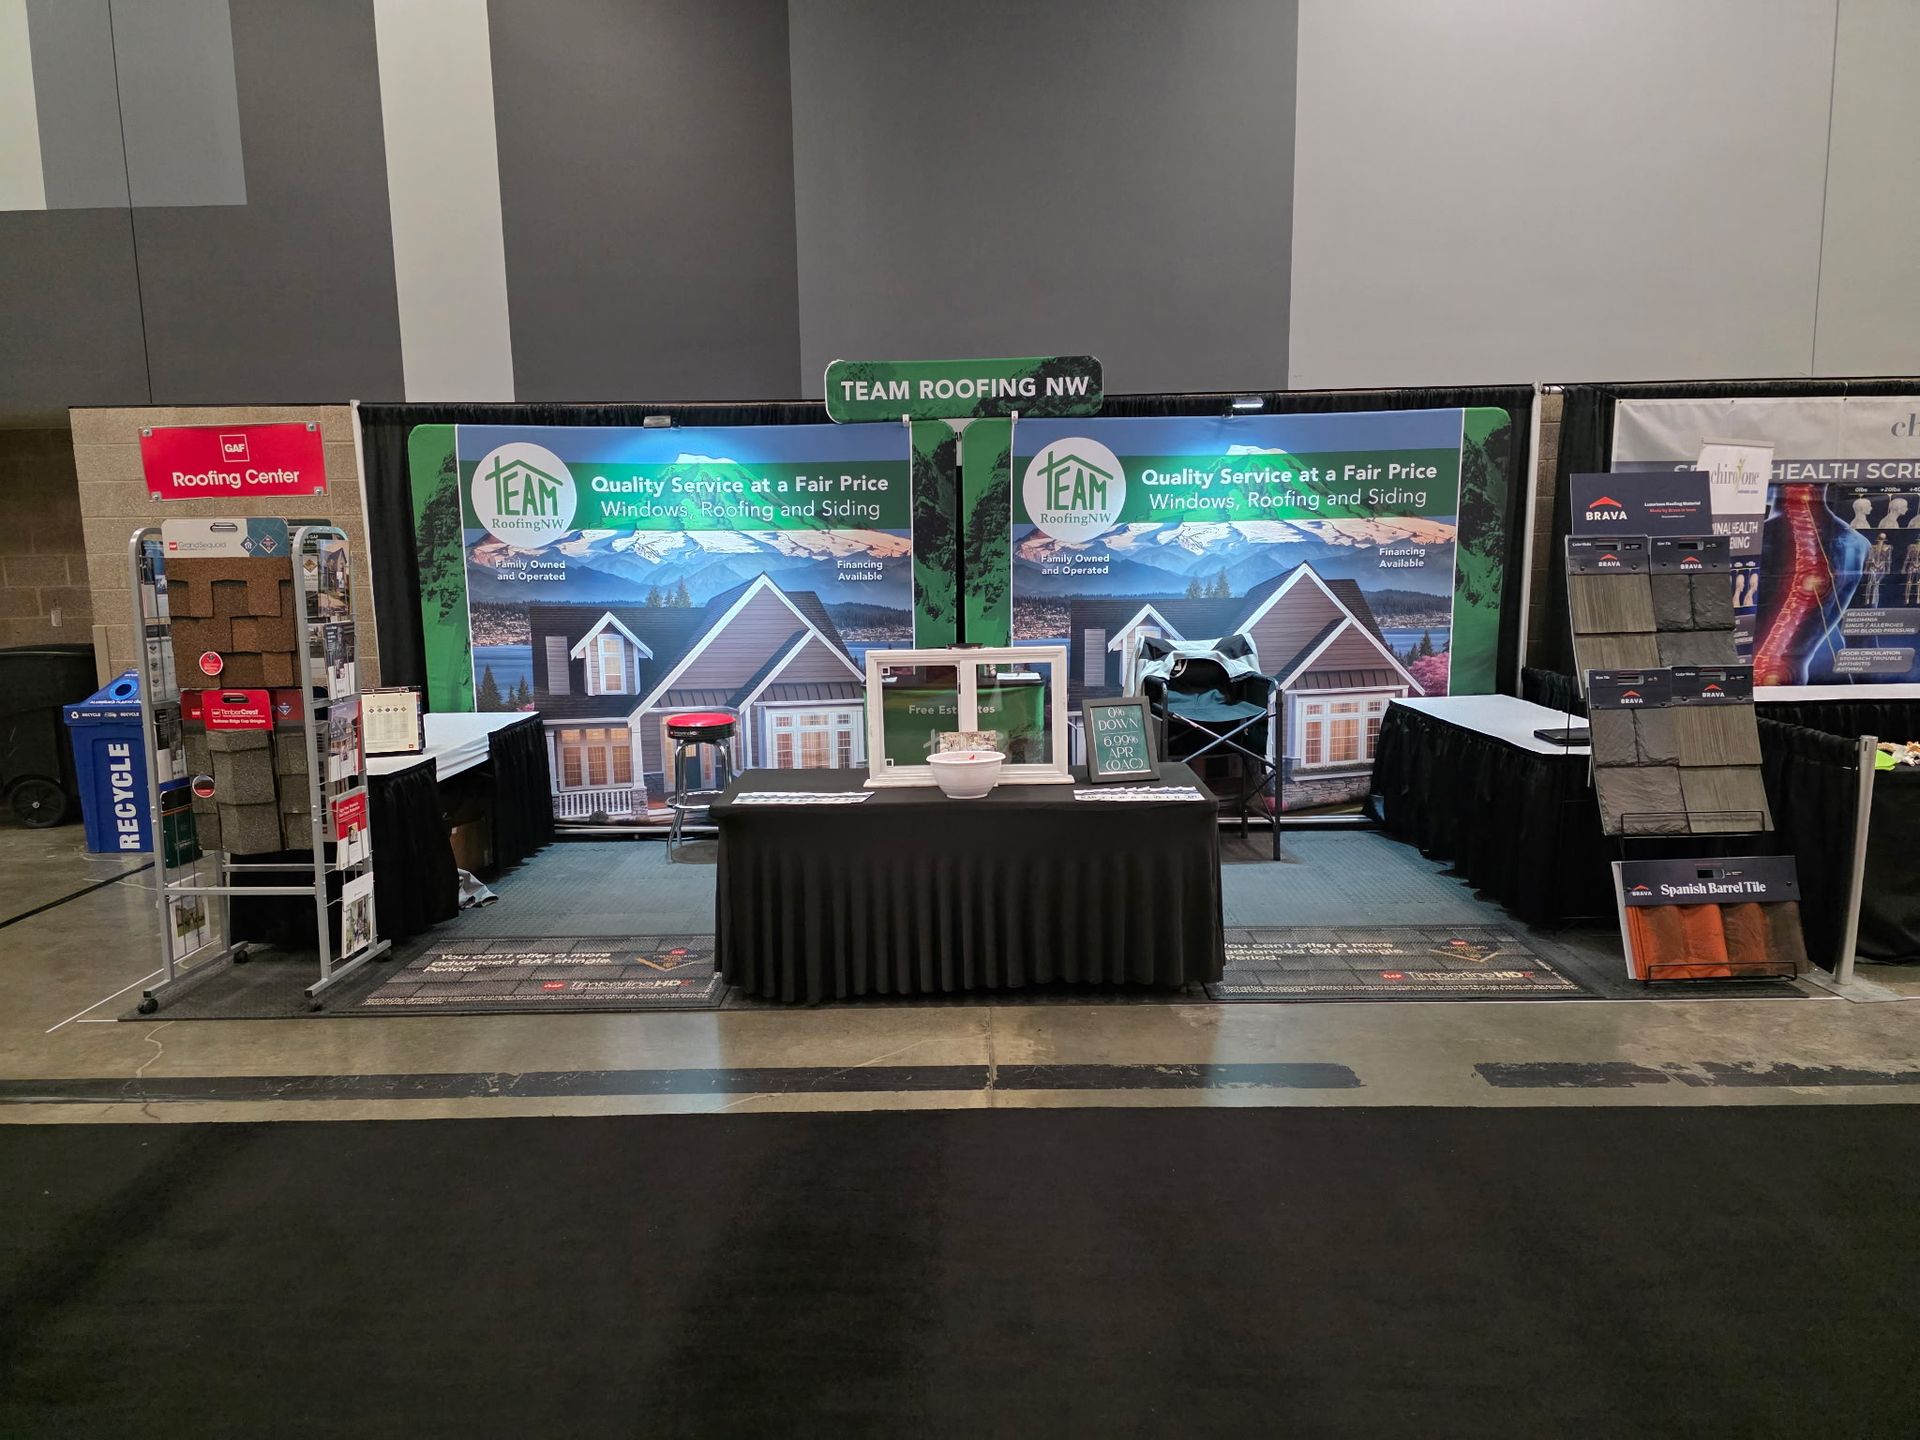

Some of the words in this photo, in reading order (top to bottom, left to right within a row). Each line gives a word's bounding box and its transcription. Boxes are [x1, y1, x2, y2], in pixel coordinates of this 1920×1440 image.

[840, 380, 910, 400] TEAM
[920, 378, 1036, 399] ROOFING
[1046, 376, 1090, 396] NW
[224, 443, 245, 453] GAF
[1142, 468, 1213, 488] Quality
[1220, 468, 1291, 484] Service
[1300, 467, 1318, 482] at
[1326, 470, 1336, 482] a
[1344, 464, 1381, 480] Fair
[1388, 463, 1437, 480] Price
[1770, 463, 1859, 480] HEALTH
[172, 470, 242, 489] Roofing
[246, 468, 300, 485] Center
[591, 476, 664, 498] Quality
[672, 476, 744, 492] Service
[750, 477, 771, 492] at
[777, 480, 788, 492] a
[796, 476, 832, 492] Fair
[840, 475, 888, 491] Price
[1150, 492, 1240, 511] Windows,
[1248, 490, 1320, 510] Roofing
[1327, 489, 1361, 506] and
[1368, 488, 1427, 508] Siding
[600, 500, 694, 520] Windows,
[702, 500, 773, 521] Roofing
[781, 501, 814, 517] and
[822, 500, 880, 520] Siding
[1586, 510, 1628, 521] BRAVA
[492, 518, 564, 532] RoofingNW
[1040, 513, 1112, 526] RoofingNW
[1732, 521, 1758, 534] HEALTH
[1379, 546, 1426, 558] Financing
[496, 560, 528, 570] Family
[530, 560, 566, 569] Owned
[837, 560, 883, 570] Financing
[1041, 554, 1072, 564] Family
[1075, 554, 1110, 564] Owned
[1379, 558, 1424, 568] Available
[497, 572, 515, 581] and
[518, 572, 566, 582] Operated
[838, 572, 883, 581] Available
[1042, 566, 1059, 575] and
[1062, 566, 1109, 576] Operated
[908, 705, 934, 714] Free
[1108, 707, 1125, 718] 0%
[1098, 718, 1138, 731] DOWN
[1104, 734, 1138, 747] 6.99%
[1110, 746, 1134, 758] APR
[1106, 758, 1144, 771] (OAC)
[108, 744, 140, 849] RECYCLE
[1660, 883, 1706, 898] Spanish
[1708, 882, 1743, 894] Barrel
[1744, 882, 1767, 893] Tile
[431, 960, 514, 968] advanced
